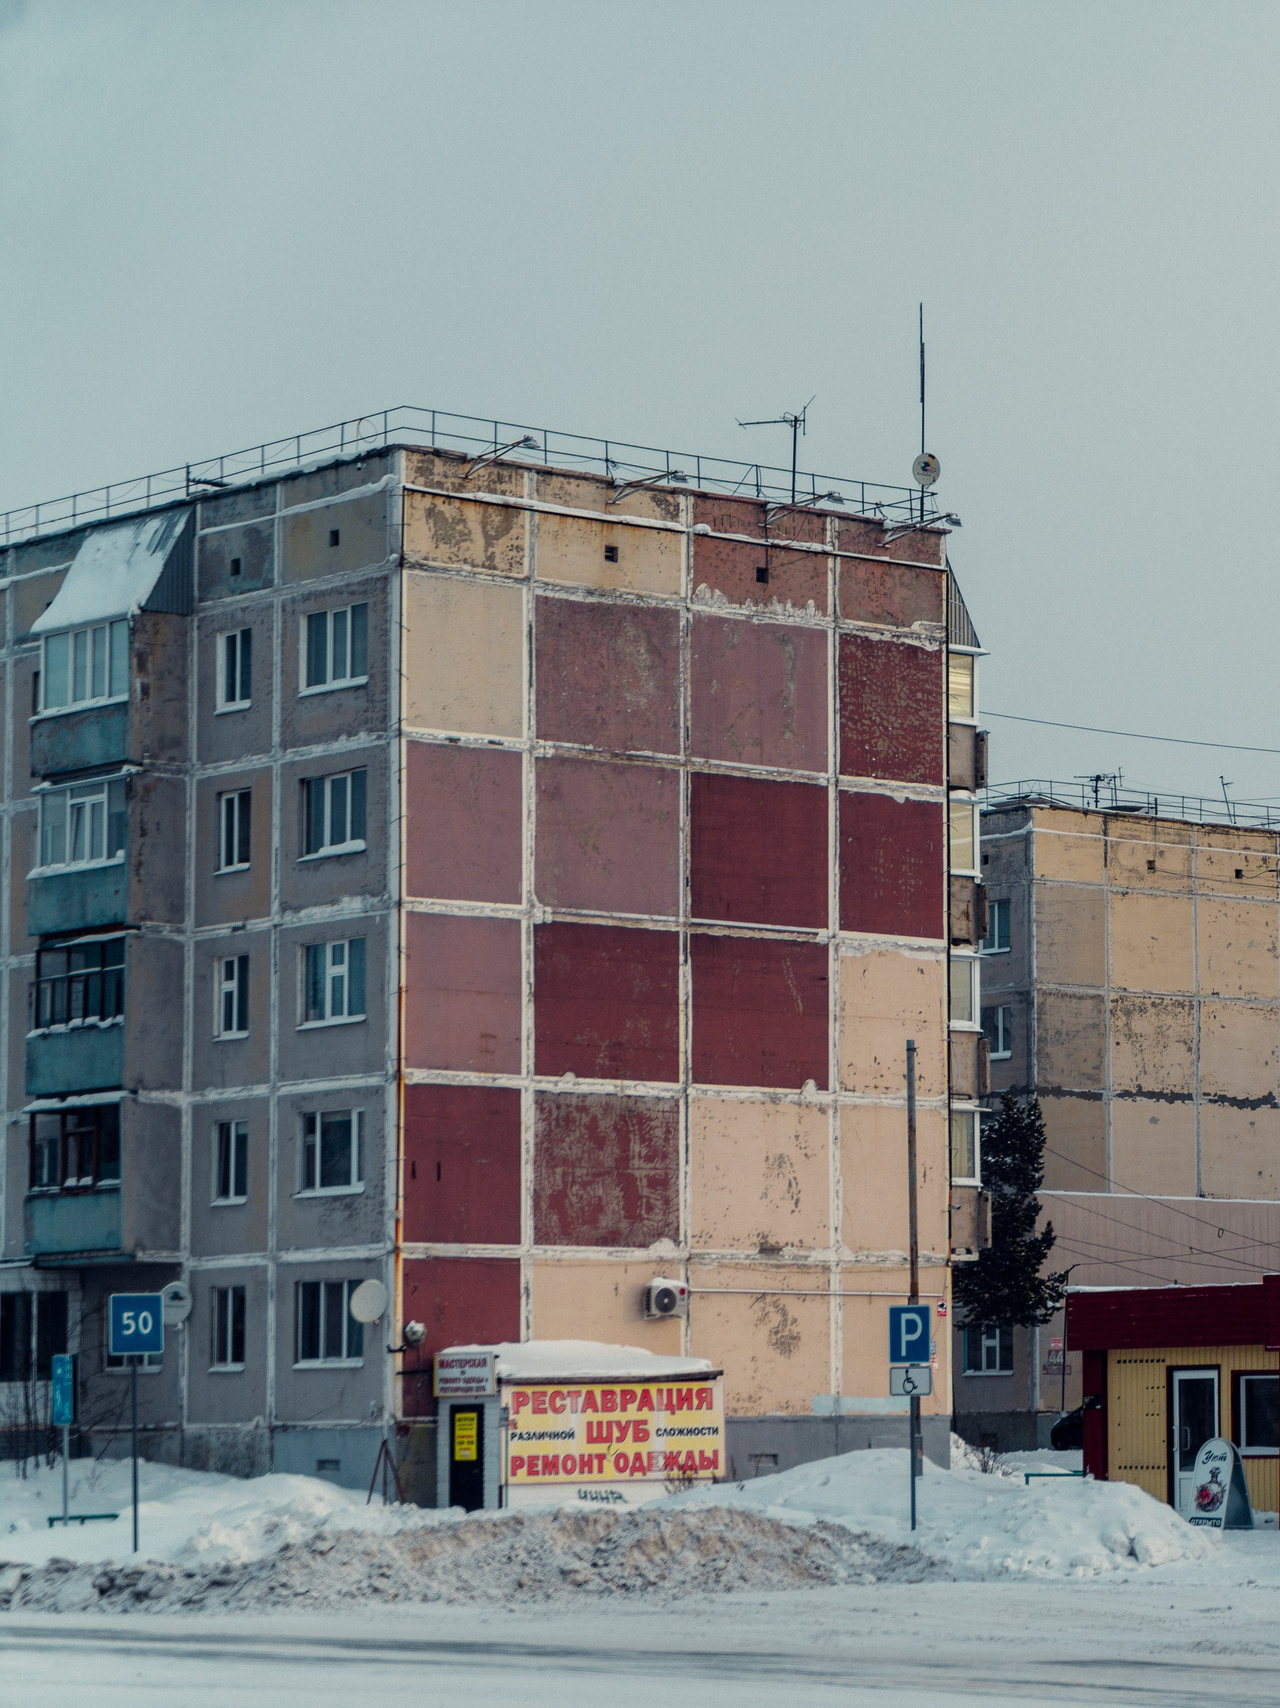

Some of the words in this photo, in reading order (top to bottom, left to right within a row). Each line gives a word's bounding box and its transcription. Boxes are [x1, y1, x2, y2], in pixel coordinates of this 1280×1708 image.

[121, 1311, 153, 1336] 50
[511, 1387, 714, 1416] РЕСТАВРАЦИЯ
[510, 1427, 575, 1441] РАЗЛИЧНОЙ
[586, 1420, 650, 1444] ШУБ
[655, 1425, 719, 1438] СЛОЖНОСТИ
[510, 1453, 607, 1478] РЕМОНТ
[613, 1449, 719, 1478] ОДЕЖДЫ
[1202, 1450, 1228, 1465] Уют
